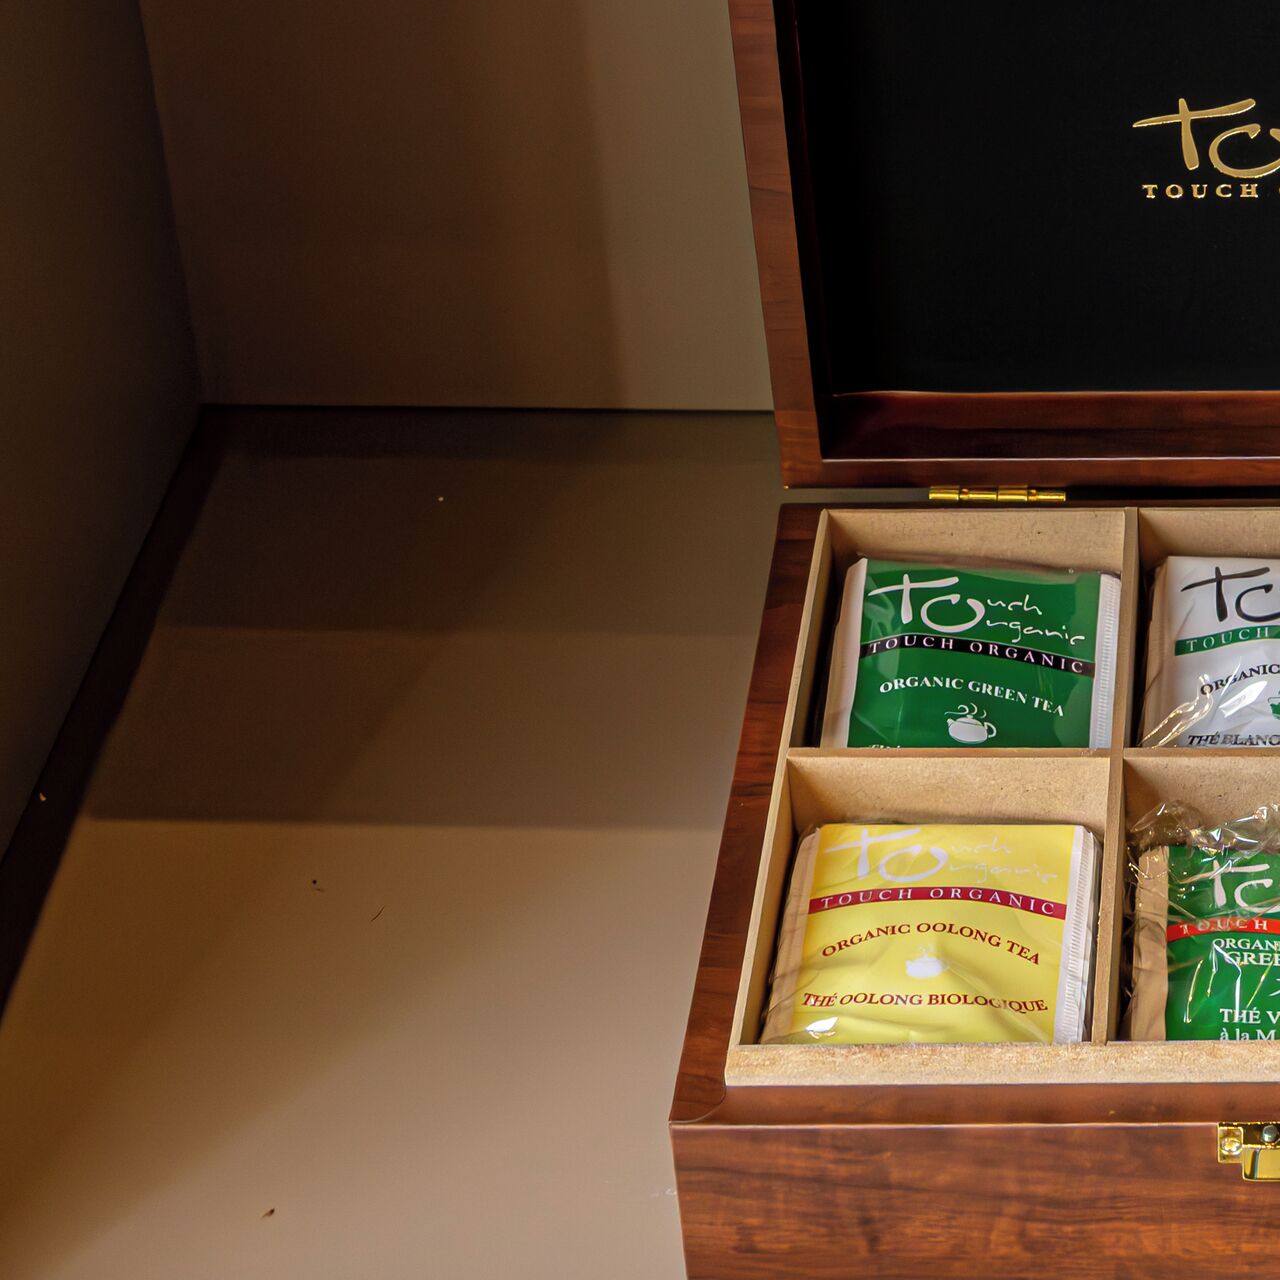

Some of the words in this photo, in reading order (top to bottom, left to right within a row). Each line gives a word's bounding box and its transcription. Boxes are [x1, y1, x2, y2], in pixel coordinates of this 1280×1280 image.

[1141, 183, 1259, 199] TOUCH
[1186, 627, 1270, 653] TOUCH
[868, 635, 954, 654] TOUCH
[969, 641, 1084, 674] ORGANIC
[1200, 663, 1280, 696] ORGANIC
[879, 676, 964, 694] ORGANIC
[968, 680, 1026, 705] GREEN
[1032, 695, 1065, 718] TEA
[1188, 731, 1219, 747] THÉ
[820, 889, 912, 909] TOUCH
[929, 887, 1055, 916] ORGANIC
[1179, 917, 1268, 936] TOUCH
[821, 923, 911, 959] ORGANIC
[916, 922, 1002, 949] OOLONG
[1006, 940, 1041, 966] TEA
[801, 992, 838, 1008] THÉ
[839, 992, 923, 1008] OOLONG
[928, 993, 1049, 1015] BIOLOGIQUE
[1219, 1007, 1261, 1025] THÉ
